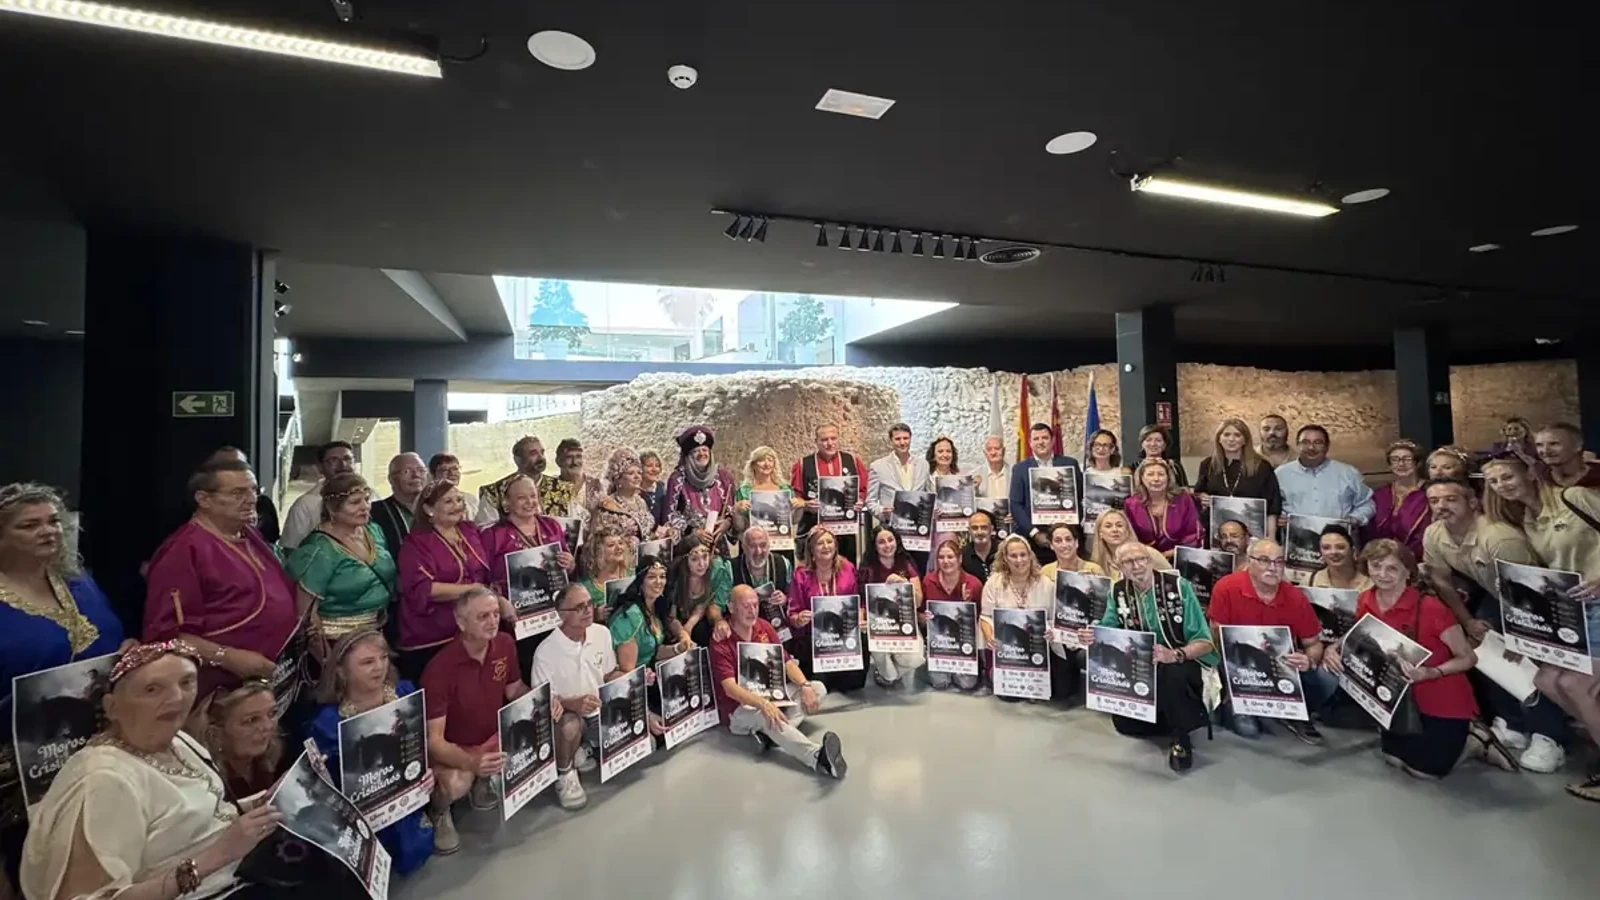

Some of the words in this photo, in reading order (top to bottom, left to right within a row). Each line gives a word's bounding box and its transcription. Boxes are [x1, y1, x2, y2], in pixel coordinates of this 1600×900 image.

[1505, 614, 1553, 633] Cristianos
[1091, 674, 1131, 688] Cristianos
[1232, 677, 1274, 688] Cristianos
[1237, 667, 1267, 679] Moros
[38, 736, 86, 759] Moros
[29, 759, 66, 779] Cristi
[358, 764, 394, 785] Moros
[350, 774, 401, 803] Cristianos
